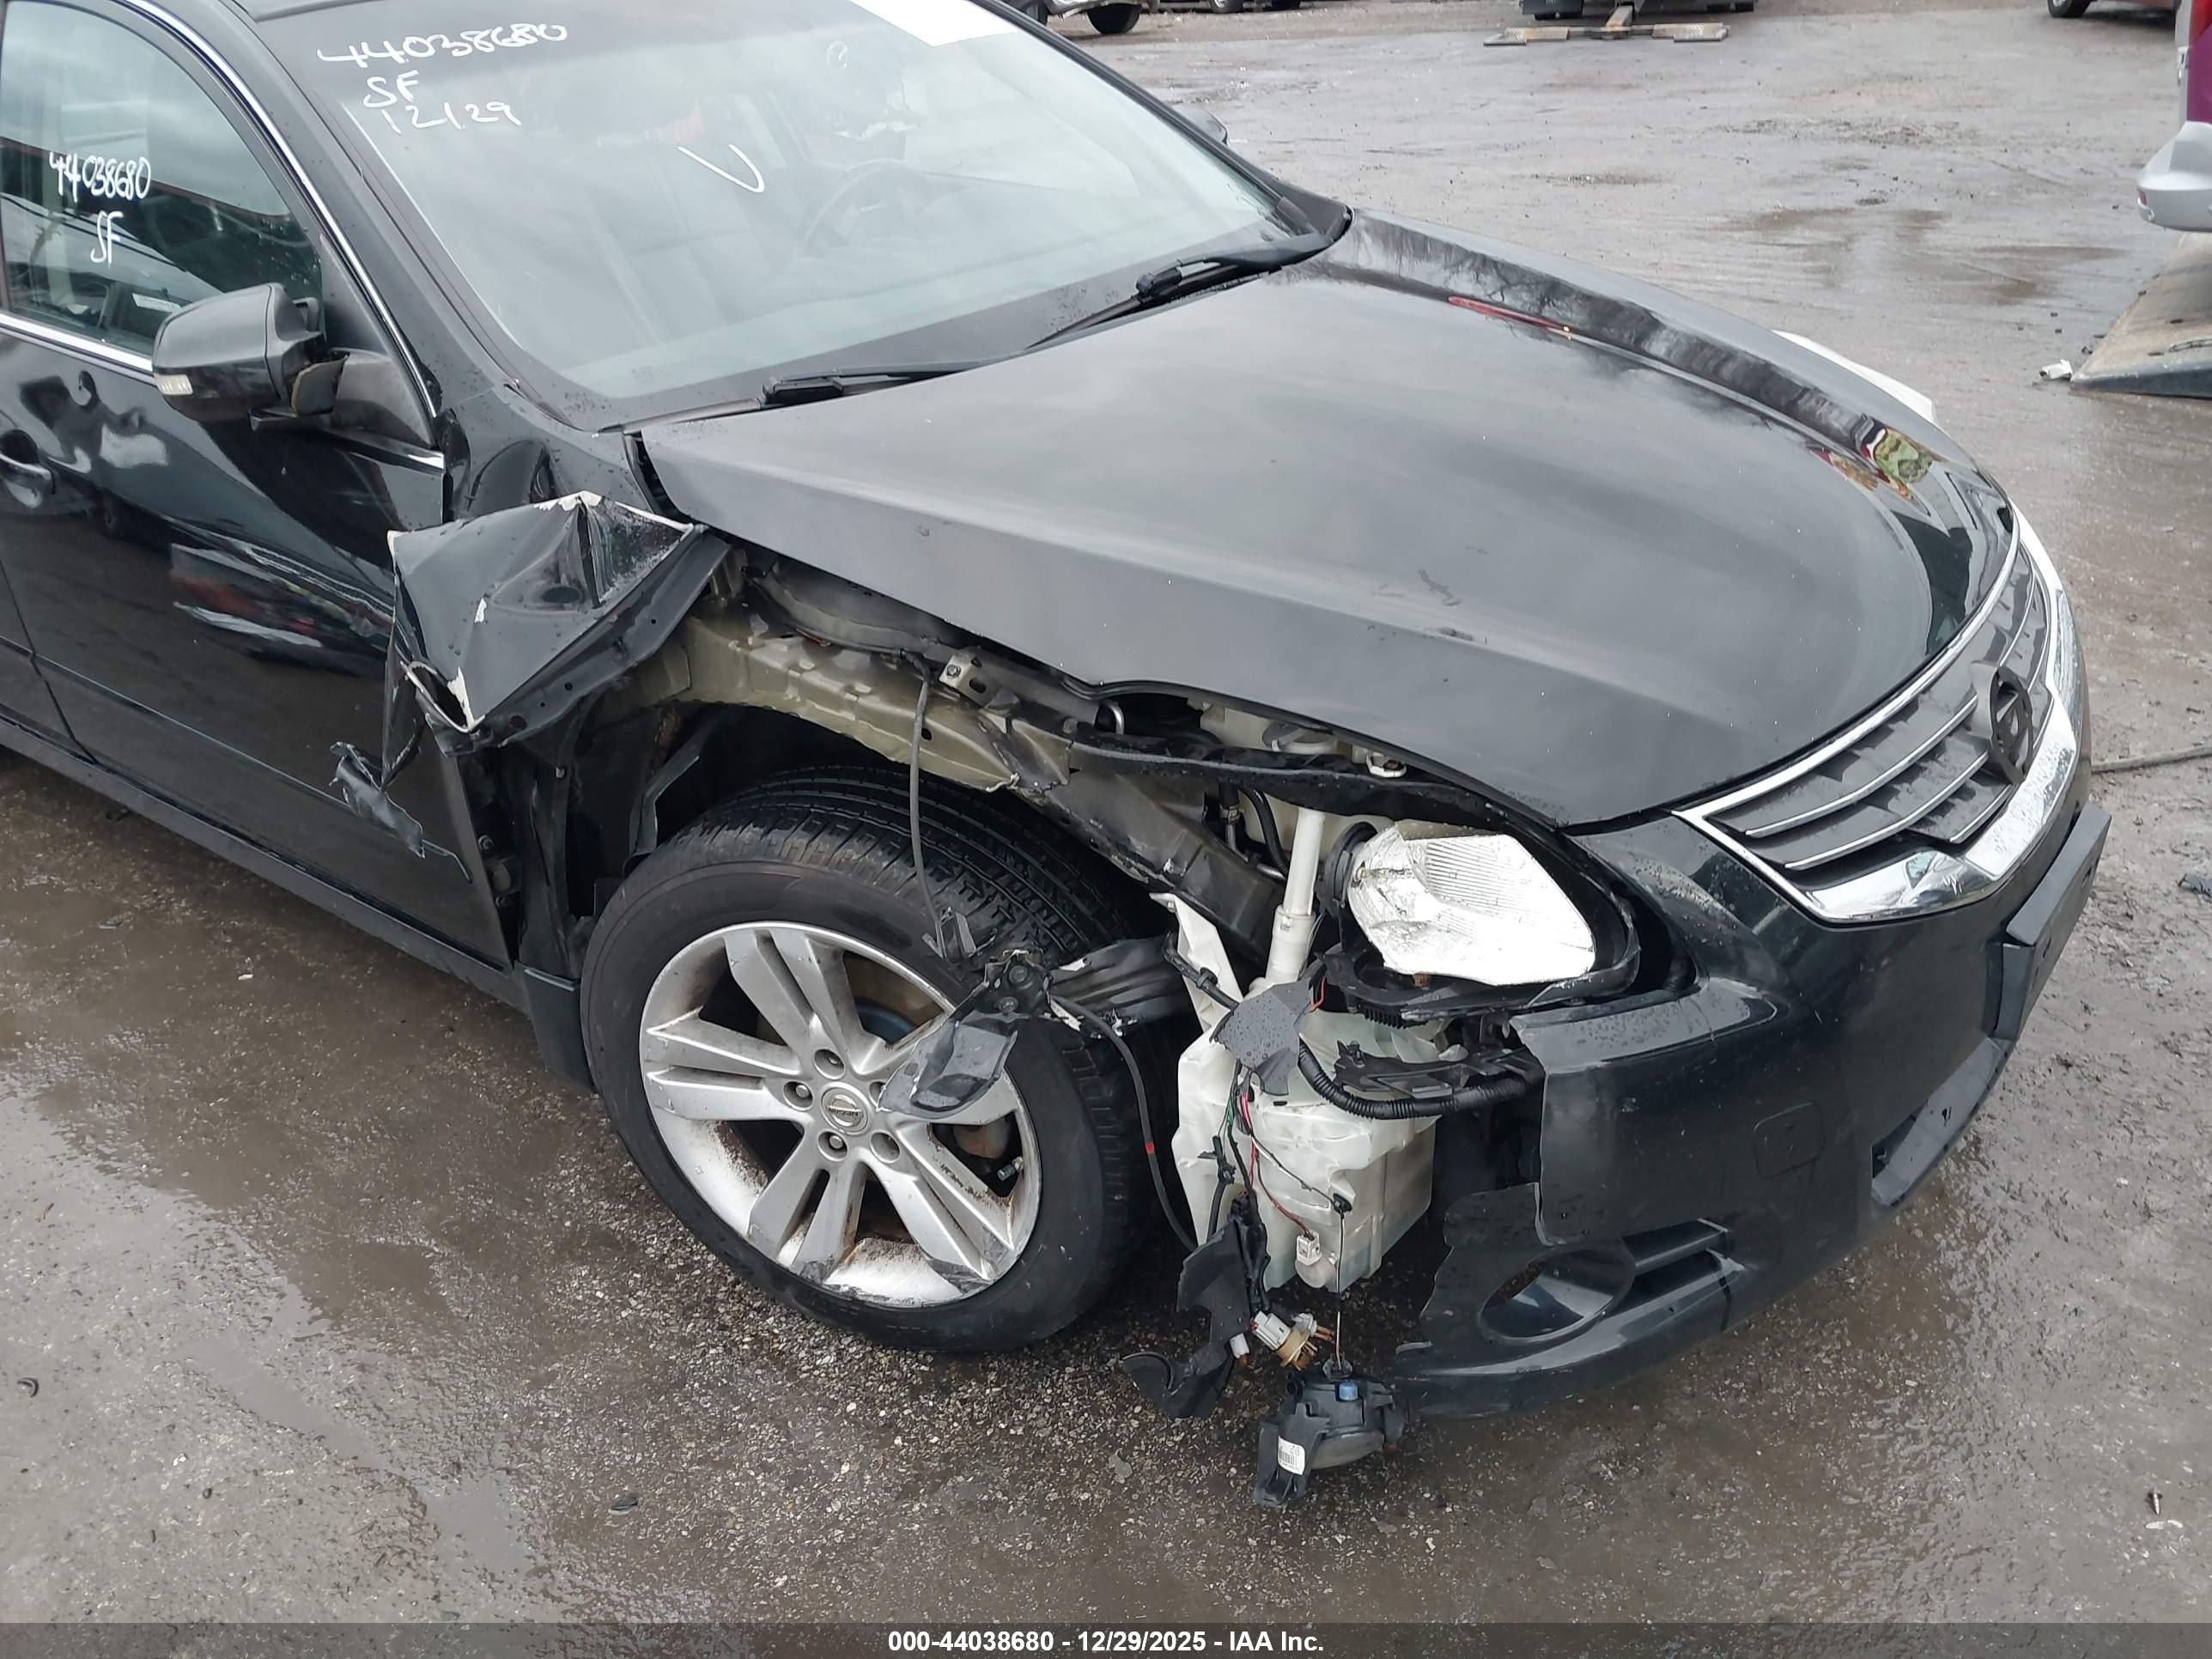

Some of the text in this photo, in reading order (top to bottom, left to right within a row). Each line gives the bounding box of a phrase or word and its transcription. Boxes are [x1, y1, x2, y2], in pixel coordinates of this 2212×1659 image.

[317, 23, 568, 68] 44038680
[362, 70, 419, 108] SF
[49, 151, 152, 204] 44038680
[90, 210, 124, 268] SF
